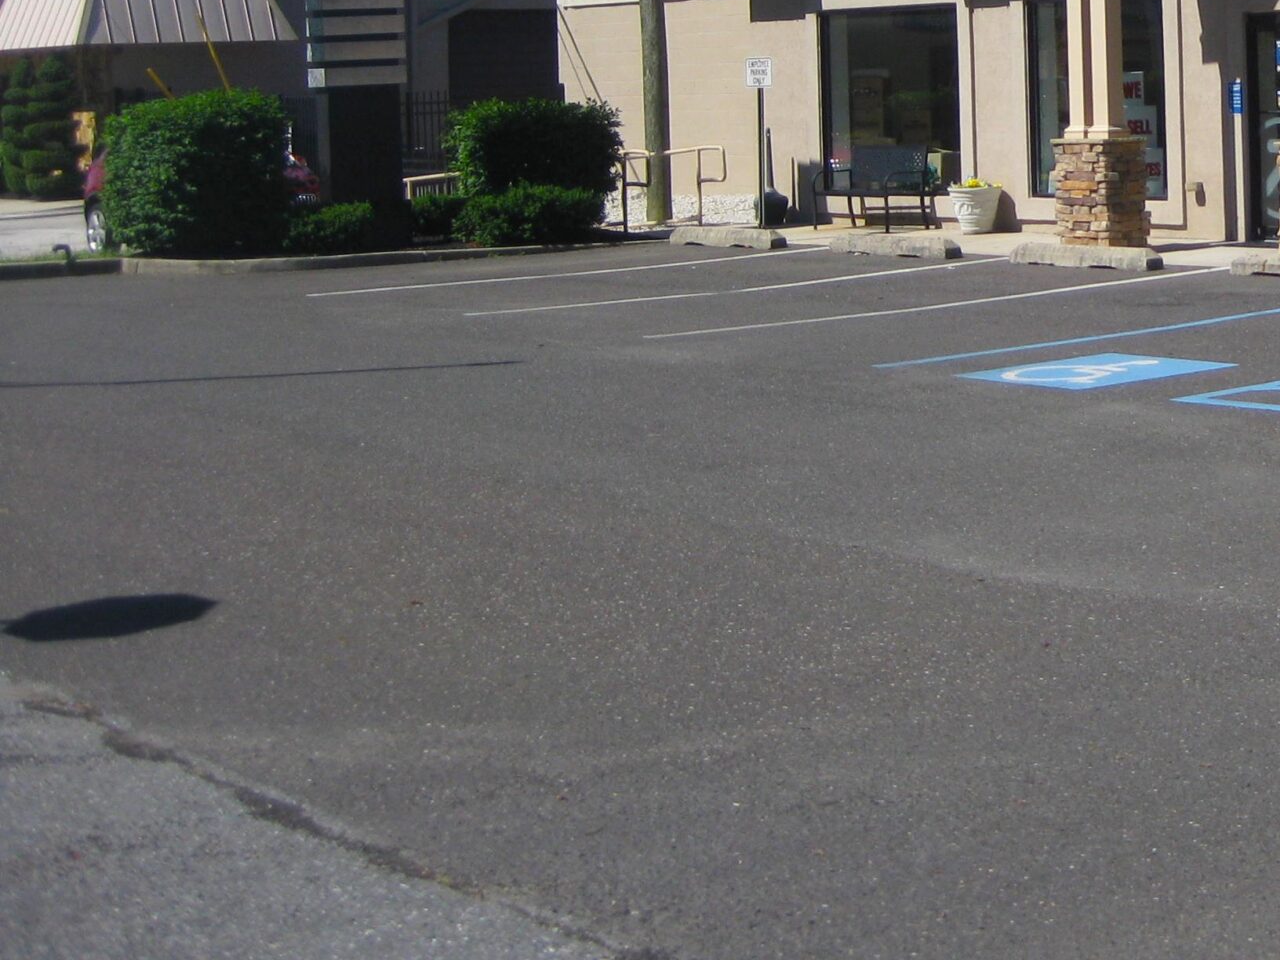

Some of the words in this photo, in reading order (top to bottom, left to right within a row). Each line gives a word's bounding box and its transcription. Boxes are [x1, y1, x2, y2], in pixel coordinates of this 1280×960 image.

[753, 77, 765, 85] ONLY
[1123, 81, 1142, 99] WE
[1128, 119, 1153, 135] SELL
